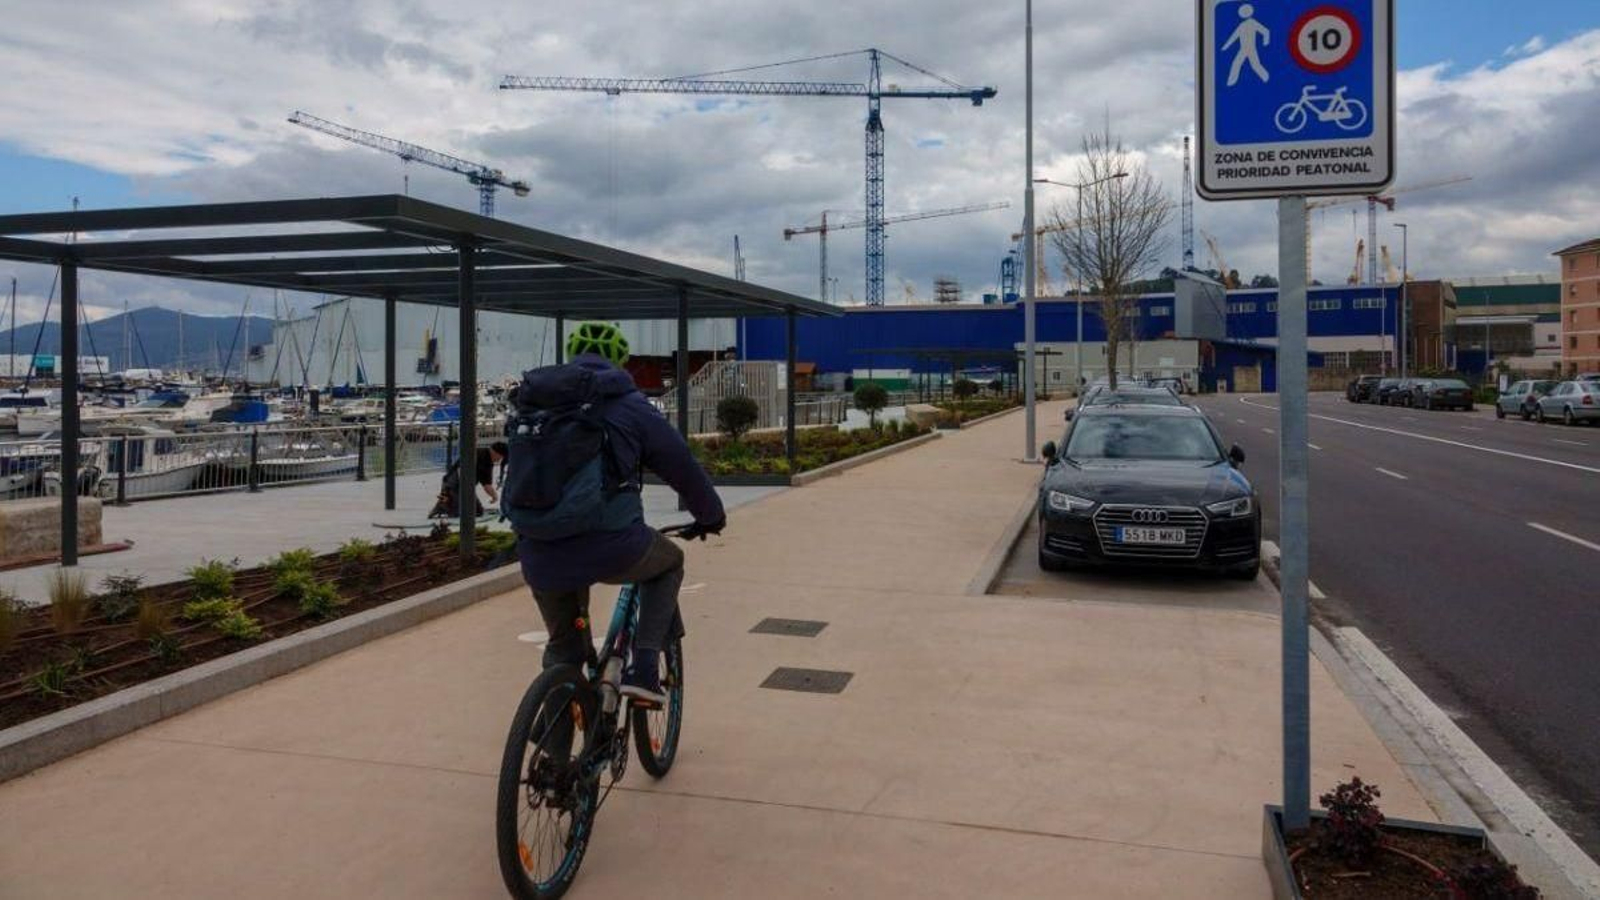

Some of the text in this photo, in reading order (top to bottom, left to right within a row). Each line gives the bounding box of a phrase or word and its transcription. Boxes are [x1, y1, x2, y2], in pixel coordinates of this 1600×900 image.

[1307, 28, 1342, 51] 10
[1214, 146, 1374, 164] ZONA DE CONVIVENCIA
[1217, 162, 1371, 179] PRIORIDAD PEATONAL
